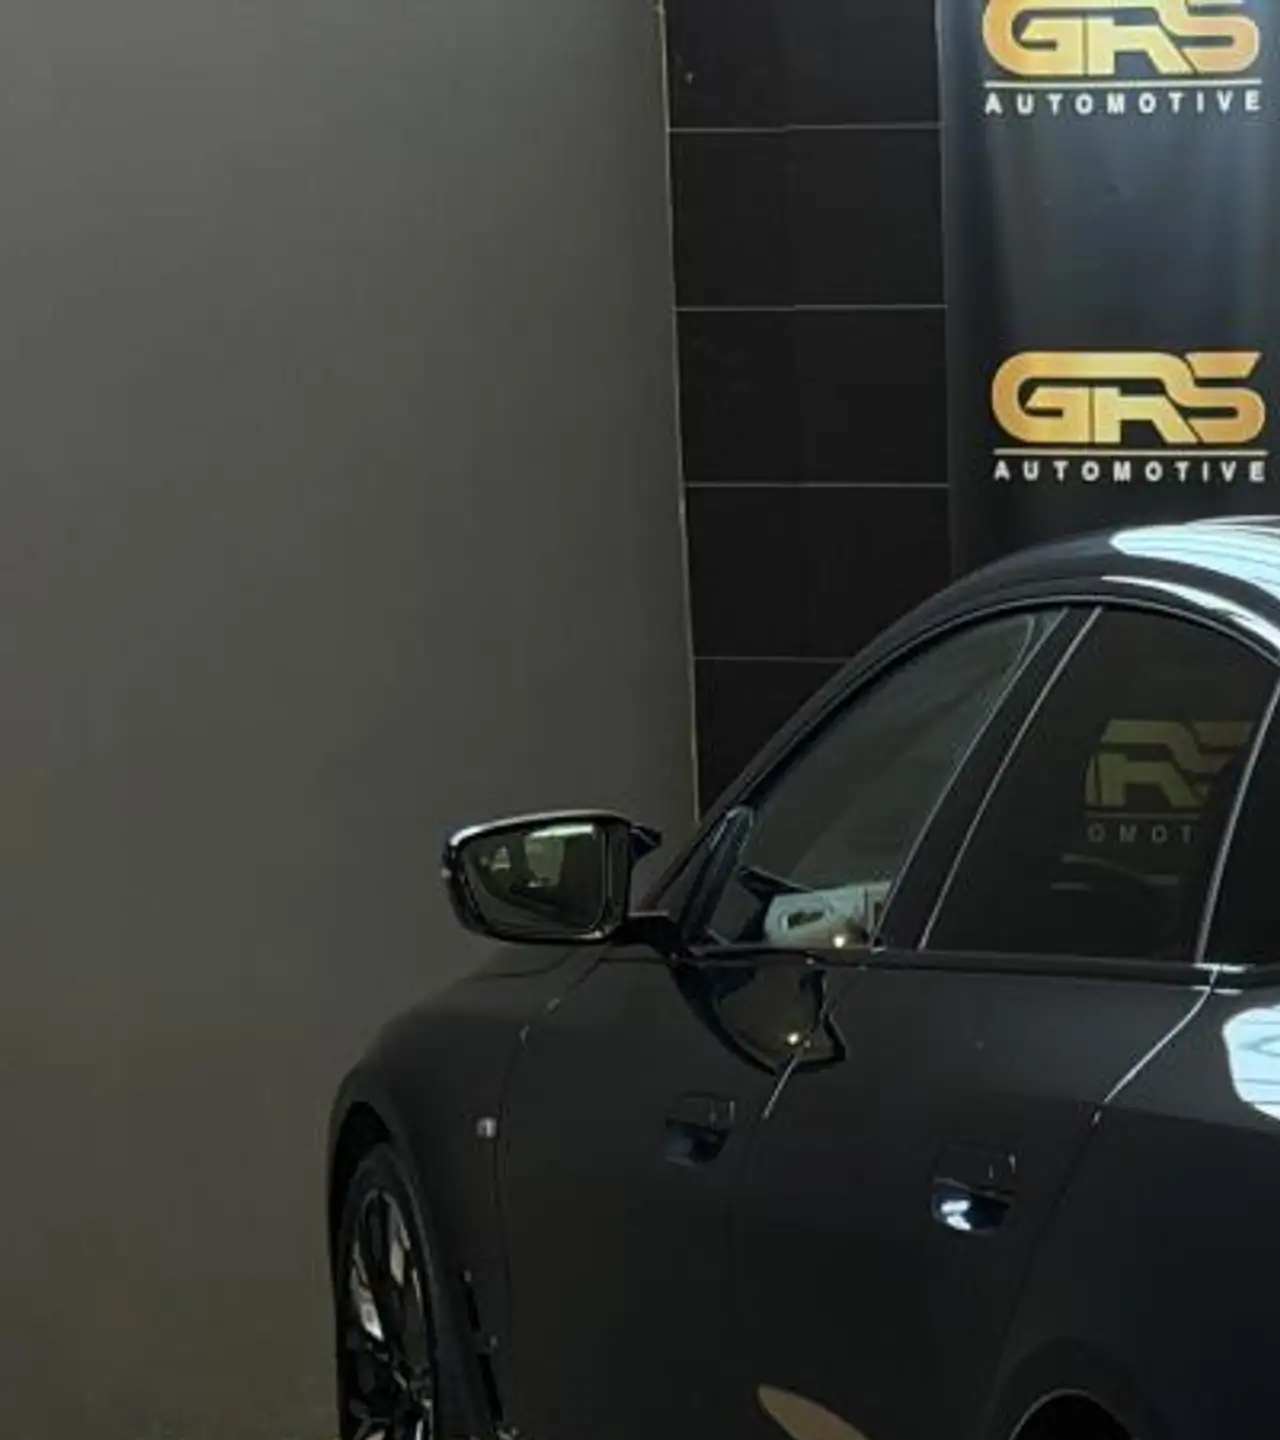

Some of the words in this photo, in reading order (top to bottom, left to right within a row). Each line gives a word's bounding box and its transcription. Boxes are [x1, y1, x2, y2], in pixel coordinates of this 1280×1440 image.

[985, 0, 1259, 76] GRS
[985, 90, 1261, 115] AUTOMOTIVE
[991, 351, 1266, 445] GRS
[993, 460, 1265, 482] AUTOMOTIVE
